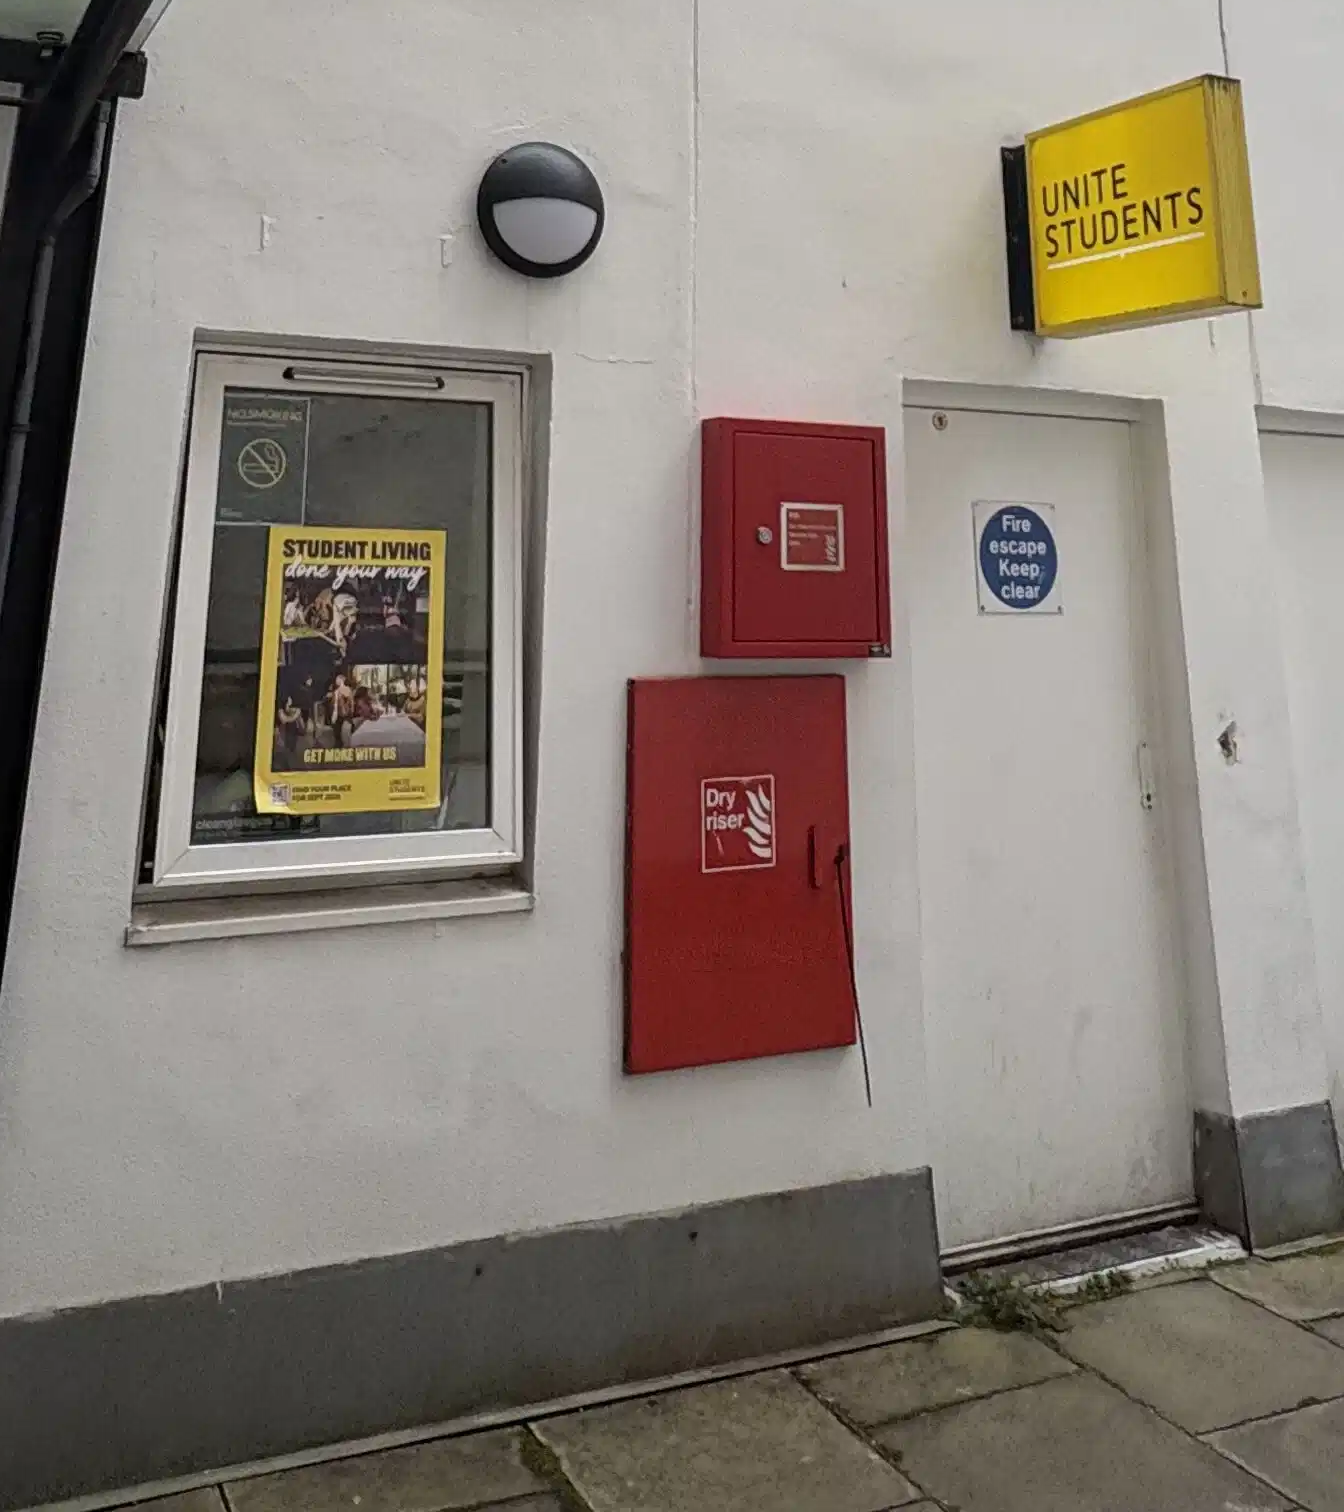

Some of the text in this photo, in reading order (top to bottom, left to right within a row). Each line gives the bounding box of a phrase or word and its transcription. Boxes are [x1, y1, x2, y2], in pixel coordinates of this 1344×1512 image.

[1042, 163, 1128, 217] UNITE
[1045, 187, 1204, 258] STUDENTS
[1002, 514, 1032, 532] Fire
[283, 539, 431, 561] STUDENT LIVING
[989, 540, 1047, 558] escape
[285, 554, 428, 590] done your way
[999, 558, 1040, 580] Keep
[1001, 581, 1041, 599] clear
[303, 746, 396, 763] GET MORE WITH US
[706, 788, 736, 811] Dry
[706, 810, 745, 831] riser
